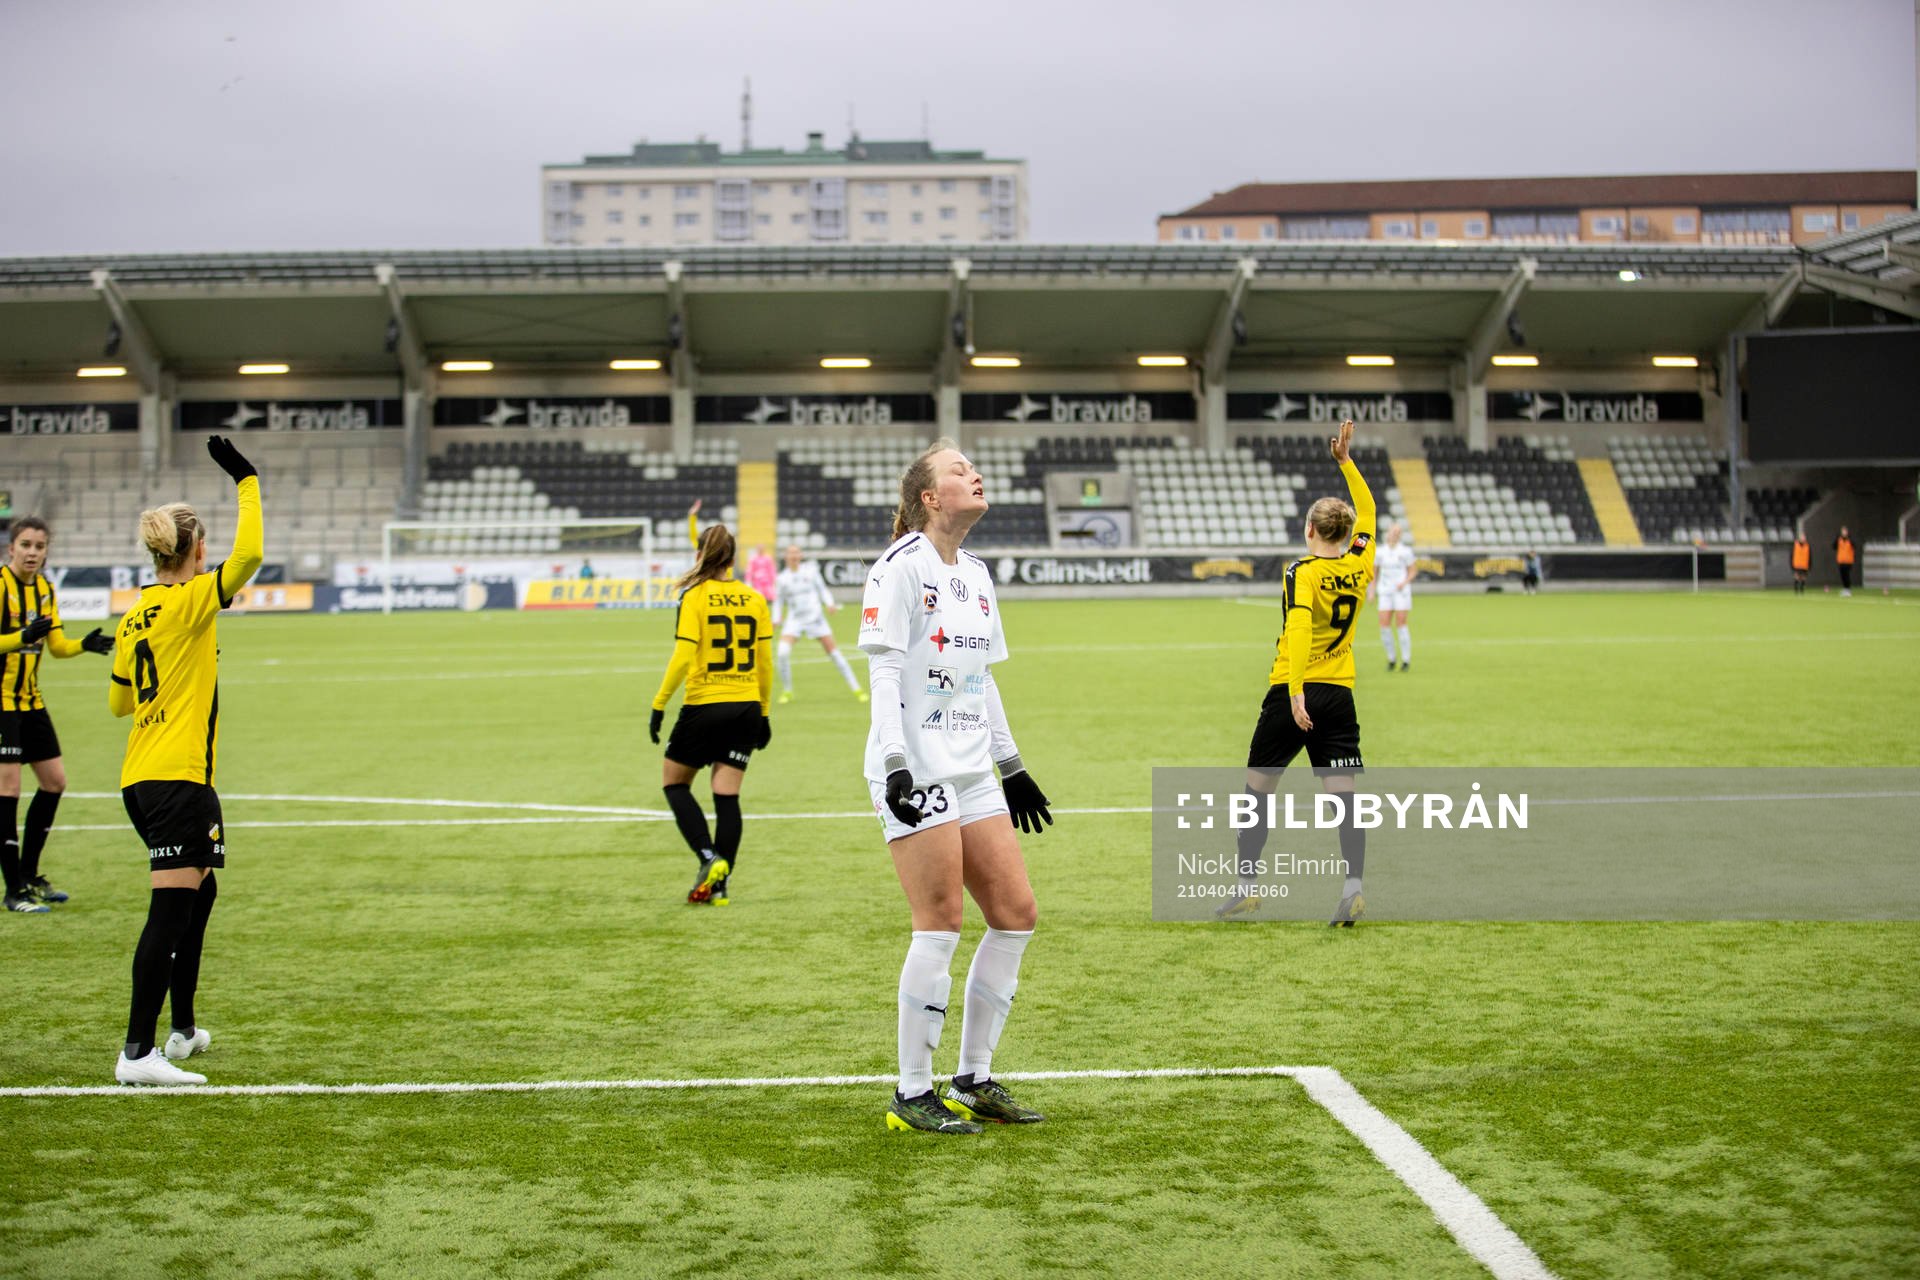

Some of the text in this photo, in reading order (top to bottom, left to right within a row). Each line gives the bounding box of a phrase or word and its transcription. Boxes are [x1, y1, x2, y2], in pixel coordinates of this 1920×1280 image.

[12, 405, 110, 434] bravida
[266, 402, 368, 431] bravida
[527, 400, 630, 428] bravida
[790, 397, 891, 425] bravida
[1051, 394, 1151, 423] bravida
[1309, 394, 1407, 423] bravida
[1563, 391, 1658, 422] bravida
[1020, 554, 1151, 585] Glimstedt
[1320, 570, 1364, 590] SKF
[709, 593, 752, 607] SKF
[1326, 595, 1358, 652] 9
[708, 615, 757, 672] 33
[910, 784, 948, 818] 23
